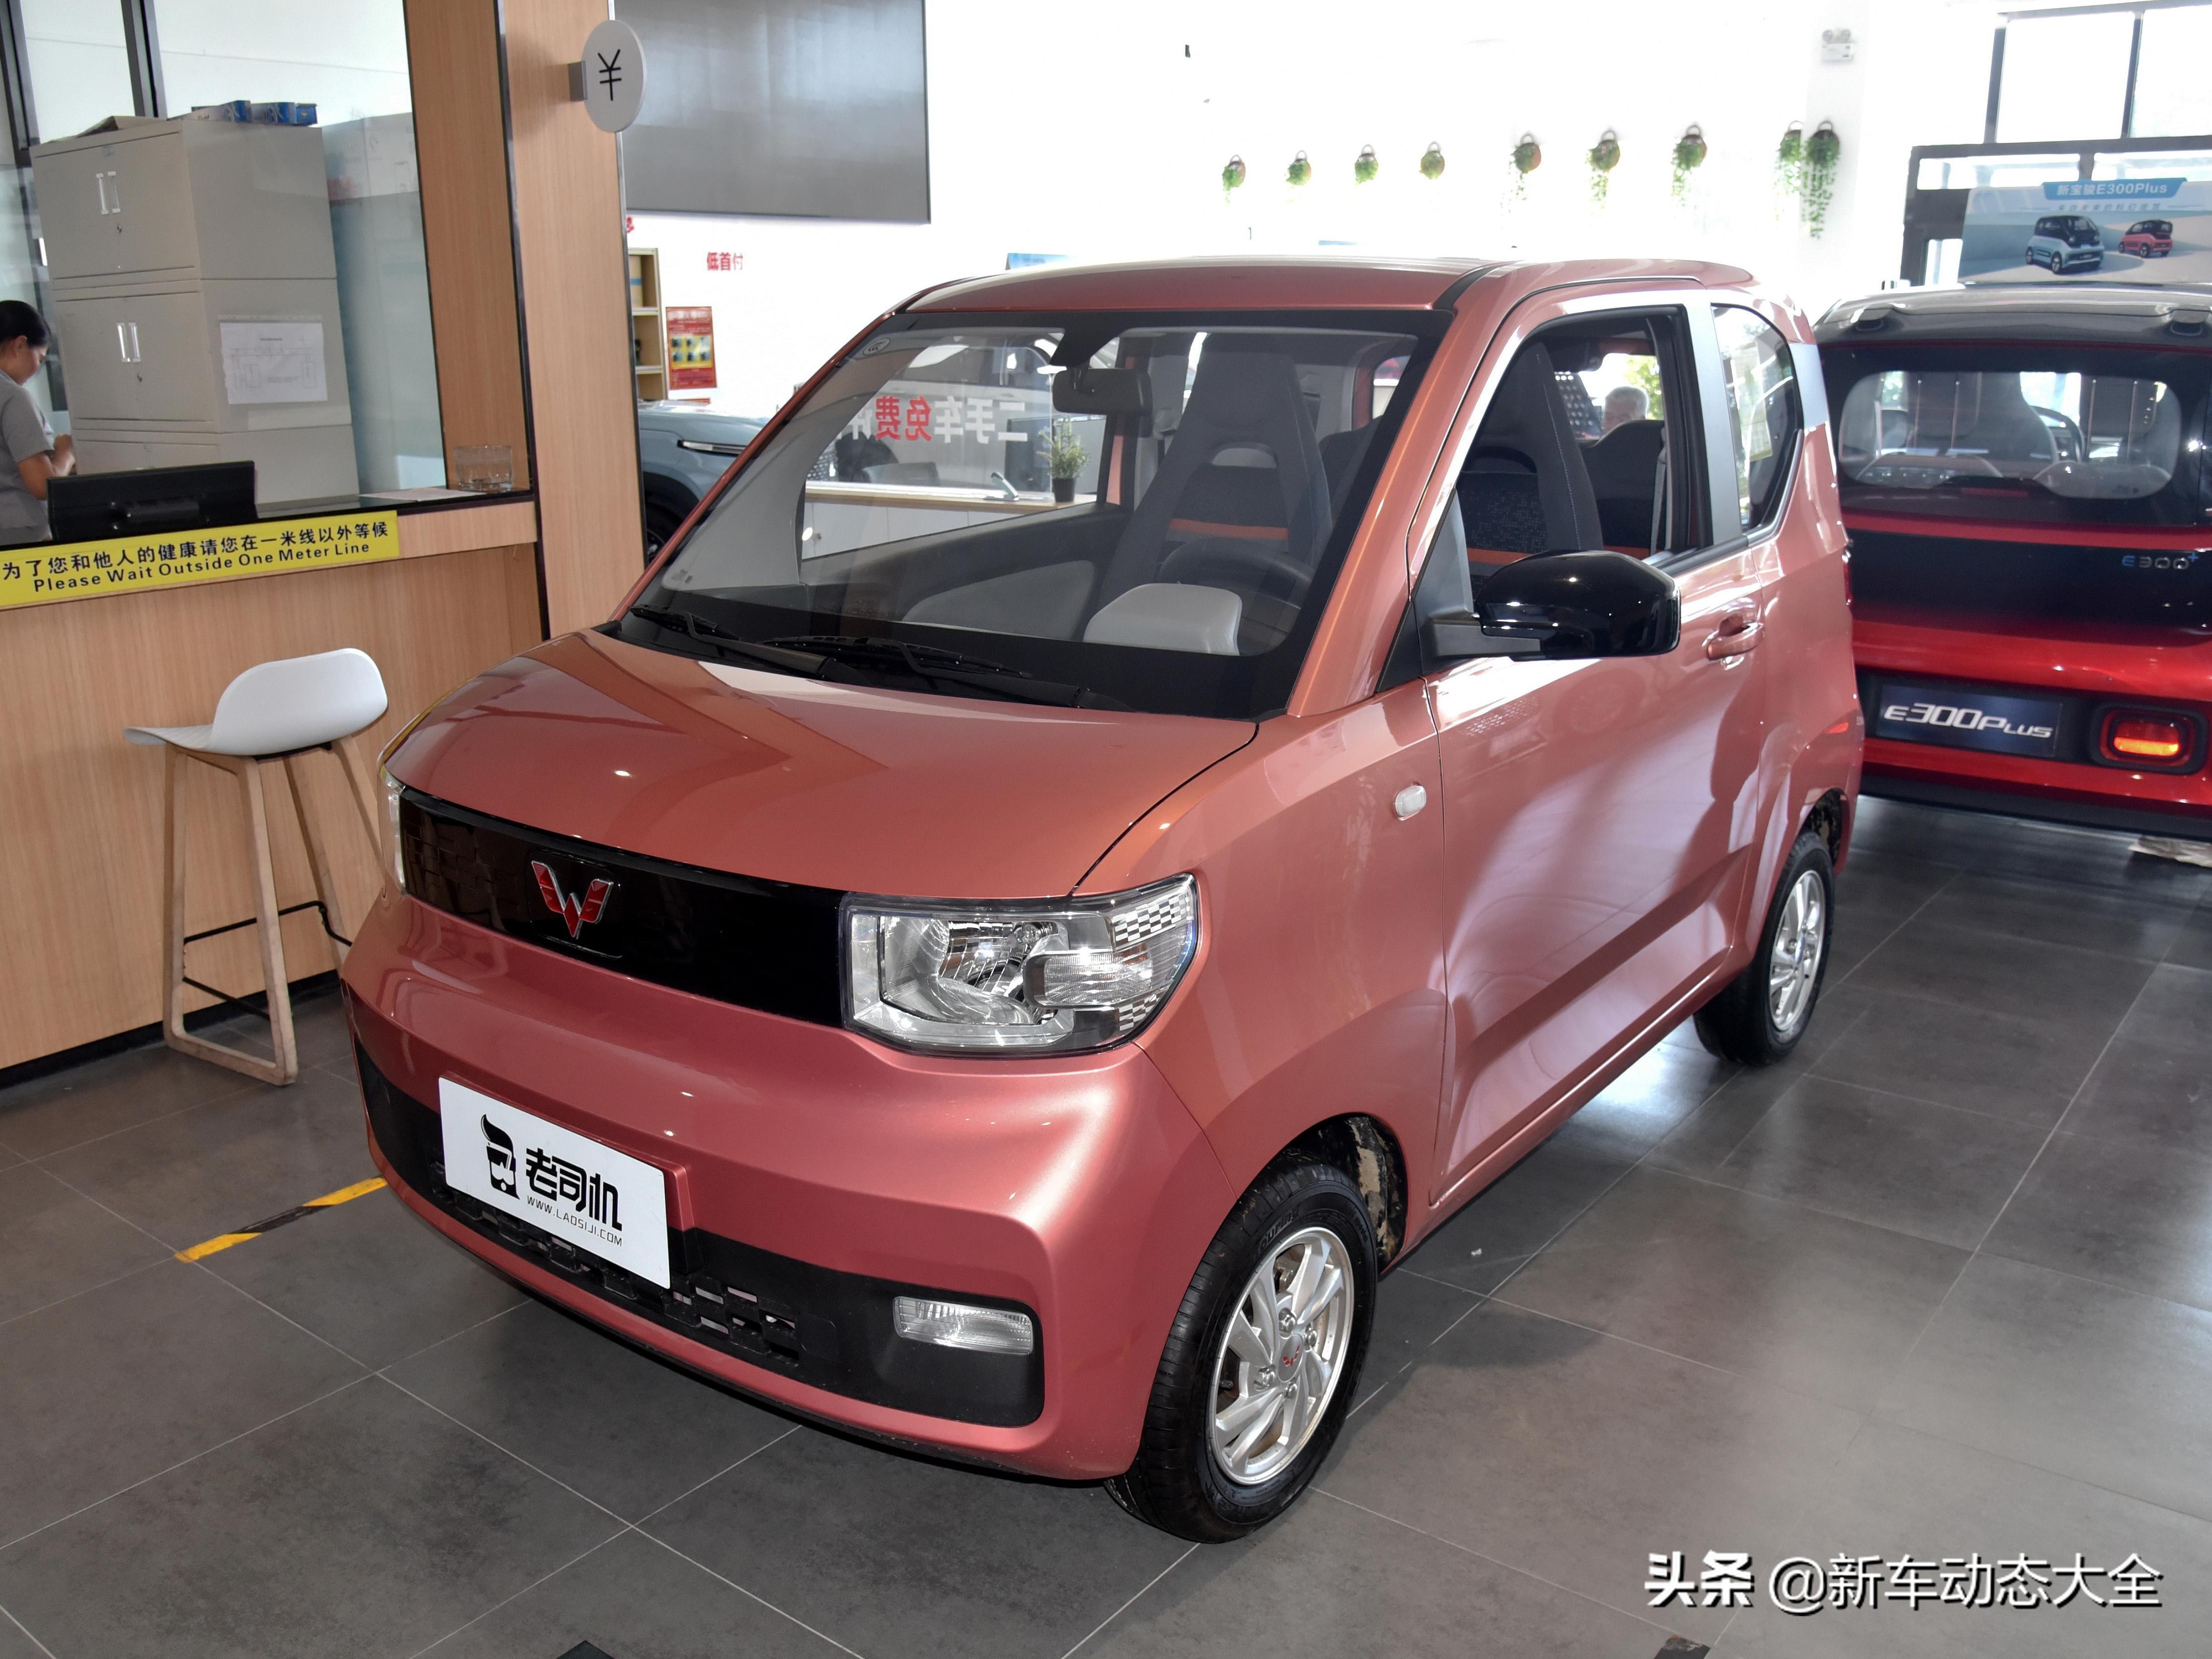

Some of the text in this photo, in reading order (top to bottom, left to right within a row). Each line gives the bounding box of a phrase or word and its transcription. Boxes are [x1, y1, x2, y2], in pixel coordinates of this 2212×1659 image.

[2056, 183, 2168, 196] 新宝骏E300Plus
[707, 251, 744, 271] 低首付
[3, 521, 389, 580] 为了您和他人的健康请您在一米线以外等候
[34, 543, 370, 592] Please Wait Outside One Meter Line
[526, 1147, 622, 1232] 老司机
[527, 1195, 622, 1247] WWW.LAOSIJI.COM
